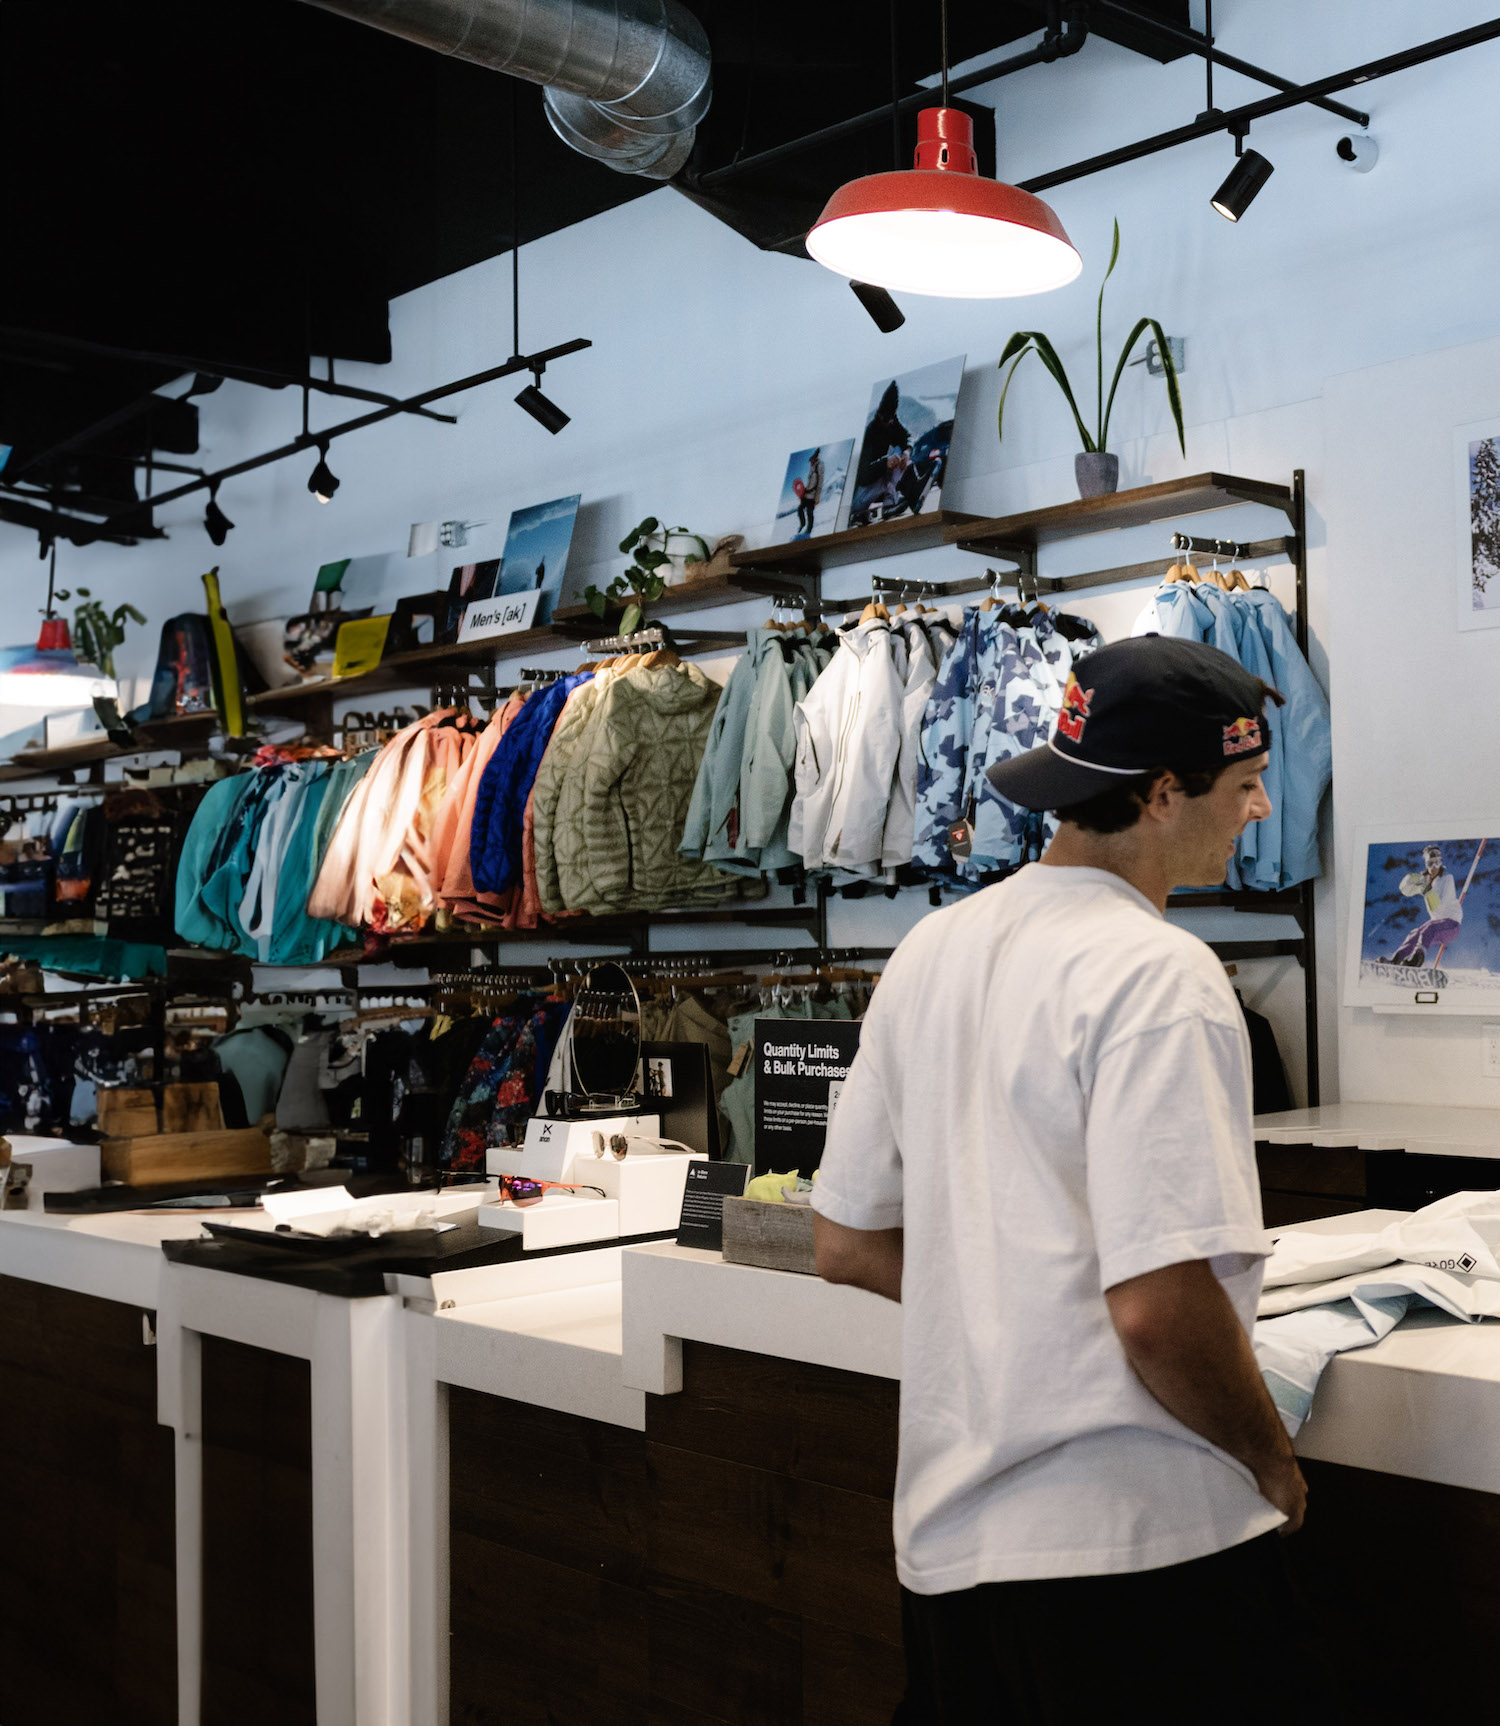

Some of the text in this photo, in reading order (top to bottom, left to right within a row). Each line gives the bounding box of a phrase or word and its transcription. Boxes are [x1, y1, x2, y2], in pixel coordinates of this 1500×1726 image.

[470, 603, 526, 628] Men's [ak]
[764, 1042, 840, 1060] Quantity Limits
[764, 1060, 772, 1074] &
[774, 1060, 796, 1075] Bulk
